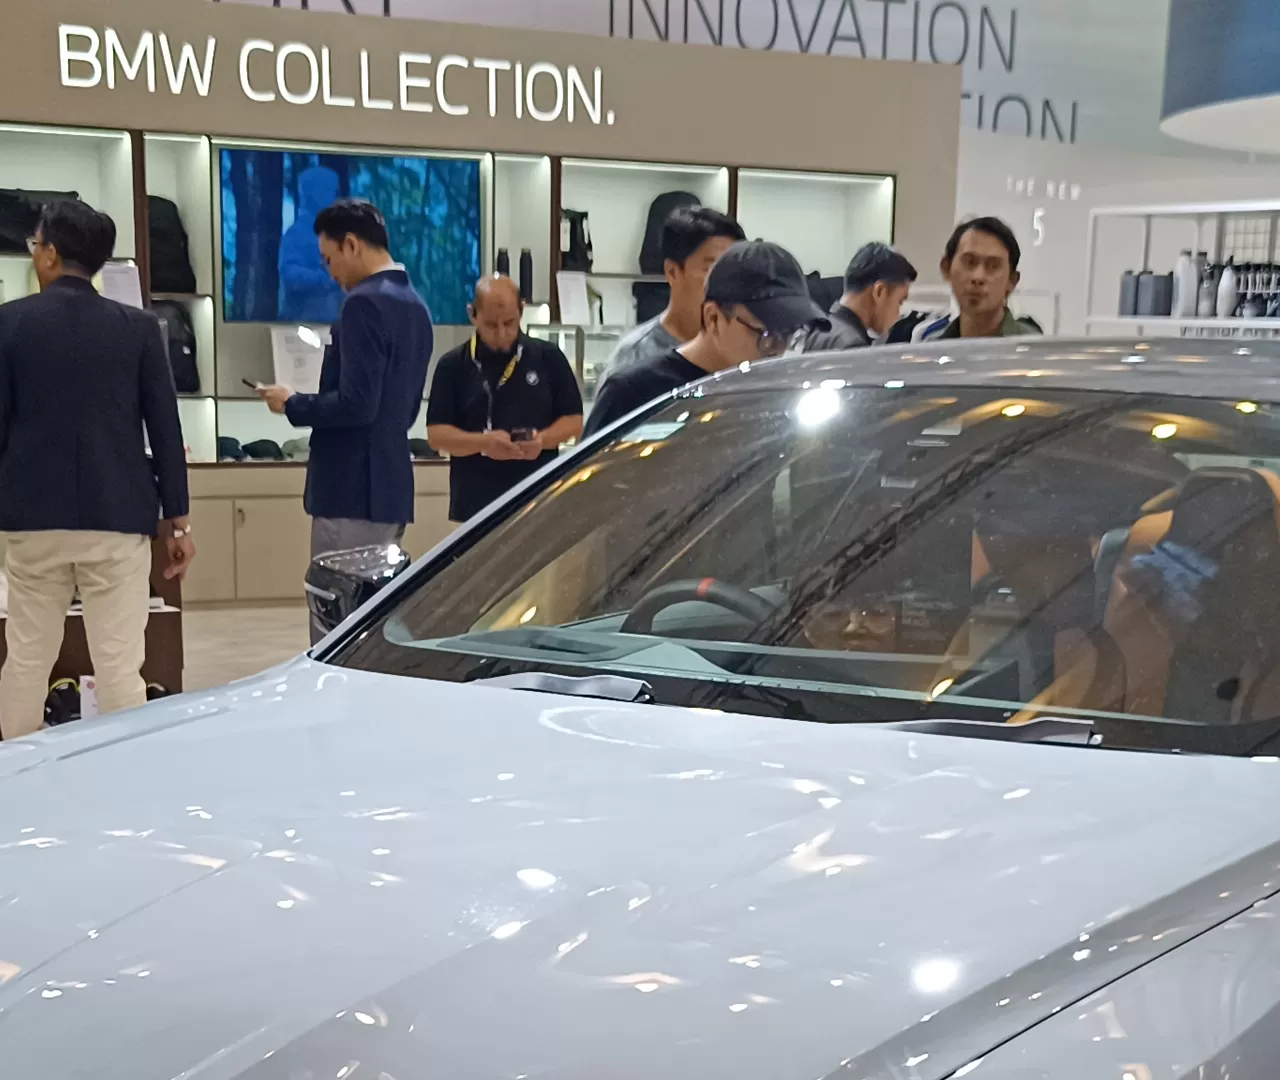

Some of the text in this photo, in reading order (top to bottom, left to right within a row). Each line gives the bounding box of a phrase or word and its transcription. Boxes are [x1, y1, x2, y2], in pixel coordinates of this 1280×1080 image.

[58, 22, 616, 126] BMW COLLECTION.
[1032, 207, 1046, 247] 5
